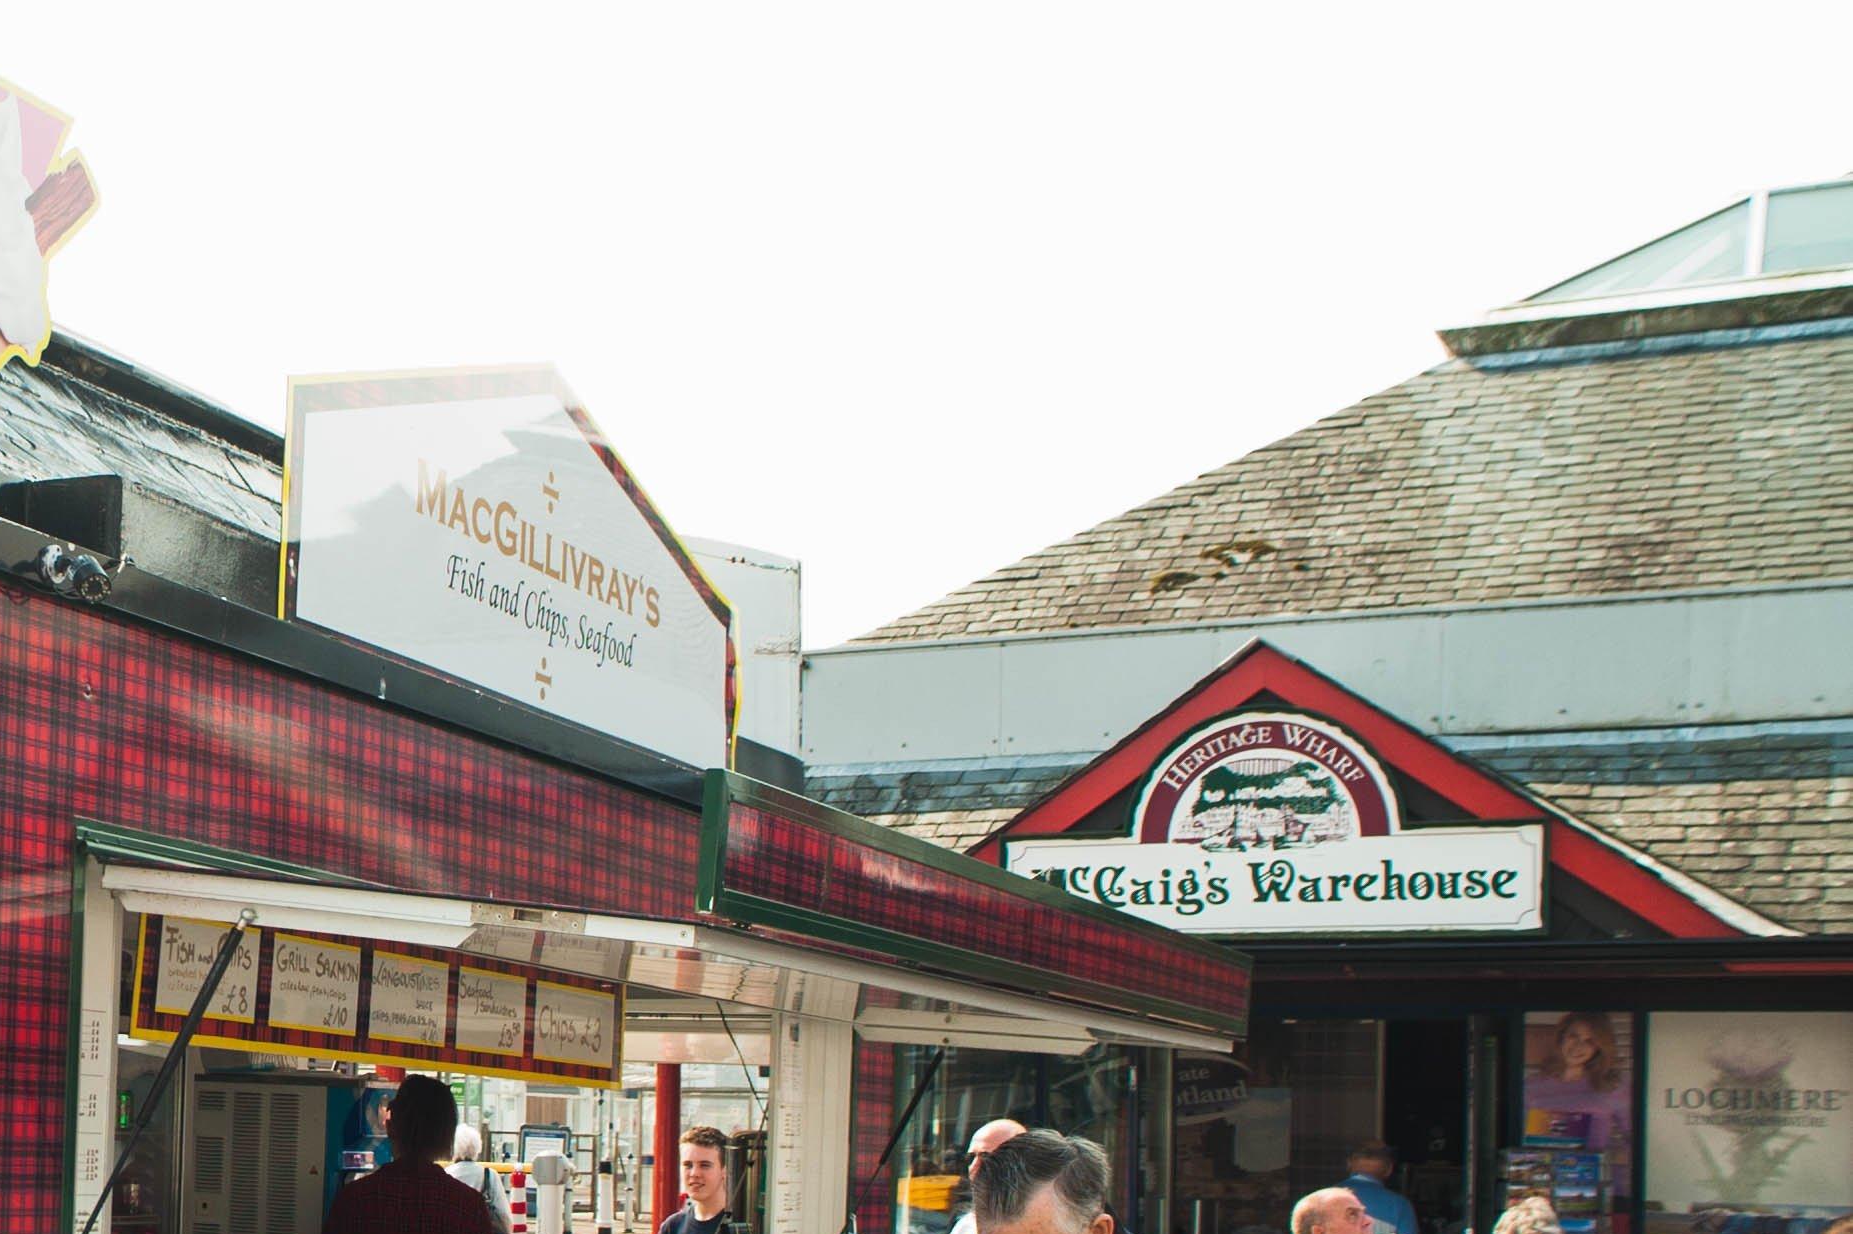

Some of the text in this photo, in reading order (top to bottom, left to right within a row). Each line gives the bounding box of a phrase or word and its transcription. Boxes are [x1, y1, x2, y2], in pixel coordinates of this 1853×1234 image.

[446, 554, 637, 668] Fish and Chips, Seafood
[1161, 723, 1365, 791] HERITAGE WHARF
[1250, 859, 1519, 904] Warehouse
[221, 985, 248, 1015] £8
[323, 1004, 347, 1027] £10
[539, 1005, 602, 1053] Chips £3
[1664, 1088, 1843, 1110] LOCHMERE
